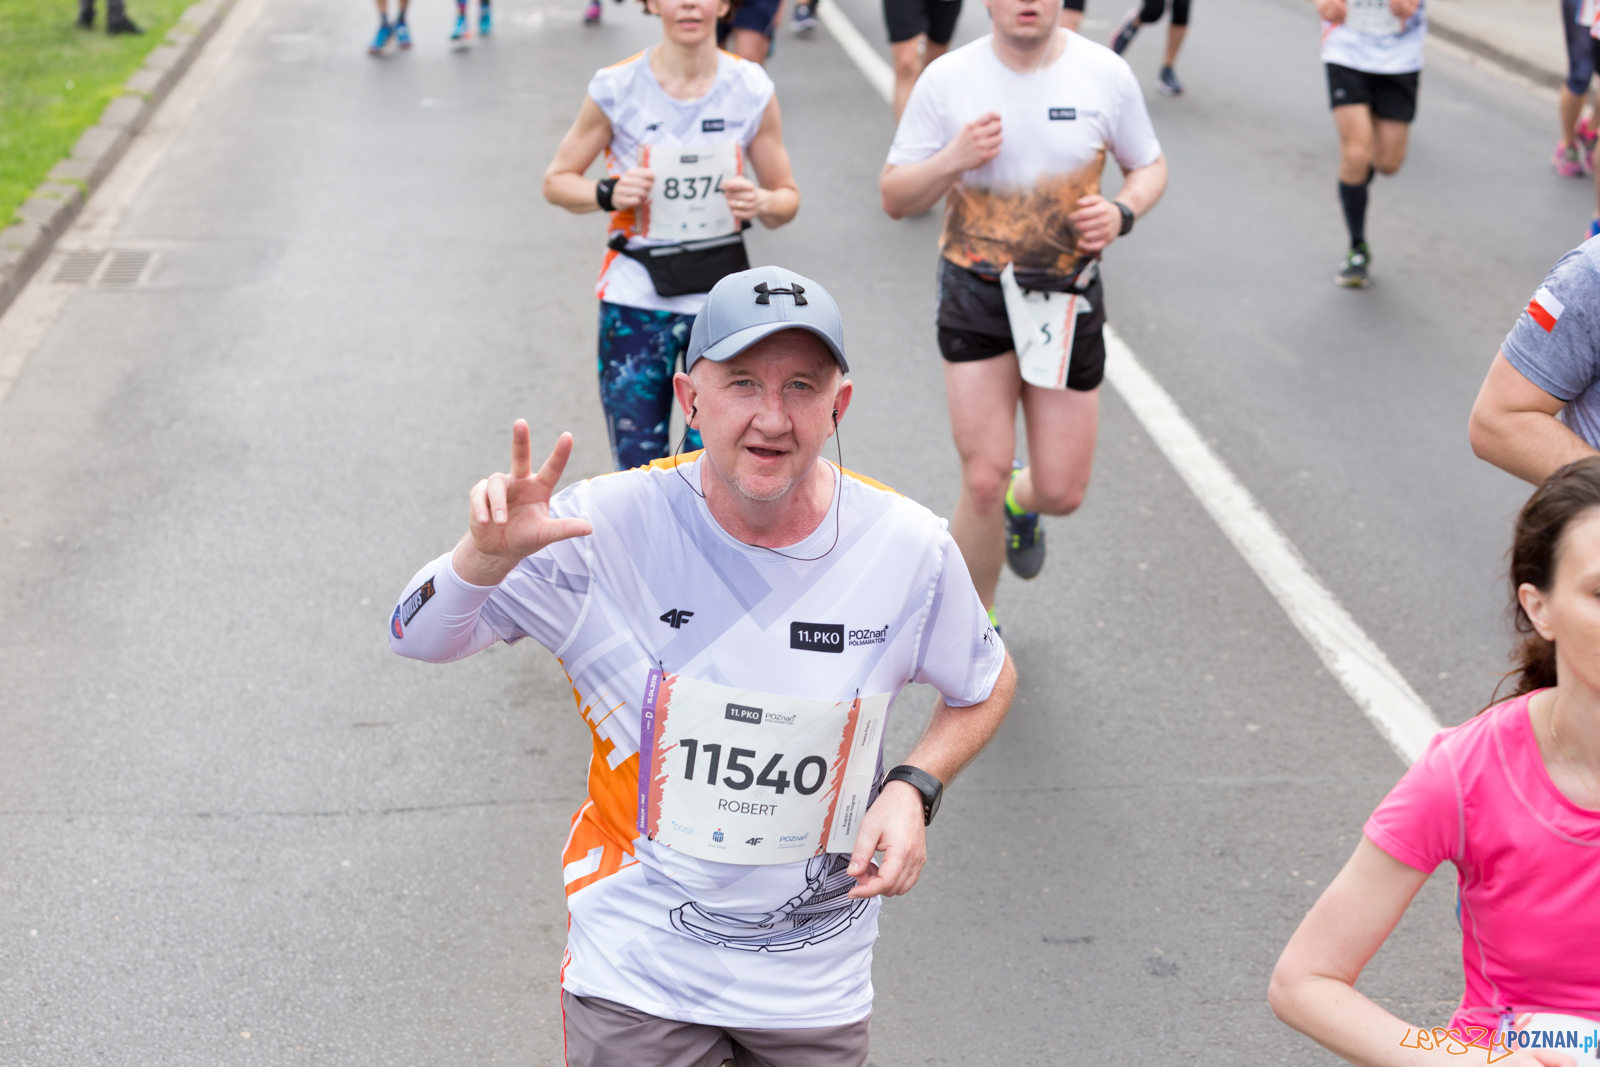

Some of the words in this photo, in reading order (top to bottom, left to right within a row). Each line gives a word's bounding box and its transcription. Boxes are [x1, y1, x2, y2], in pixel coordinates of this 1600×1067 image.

[659, 608, 695, 629] 4F
[814, 631, 840, 645] PKO
[646, 673, 658, 704] 15.04.2018
[679, 738, 828, 796] 11540
[717, 798, 778, 816] ROBERT
[745, 837, 764, 846] 4F
